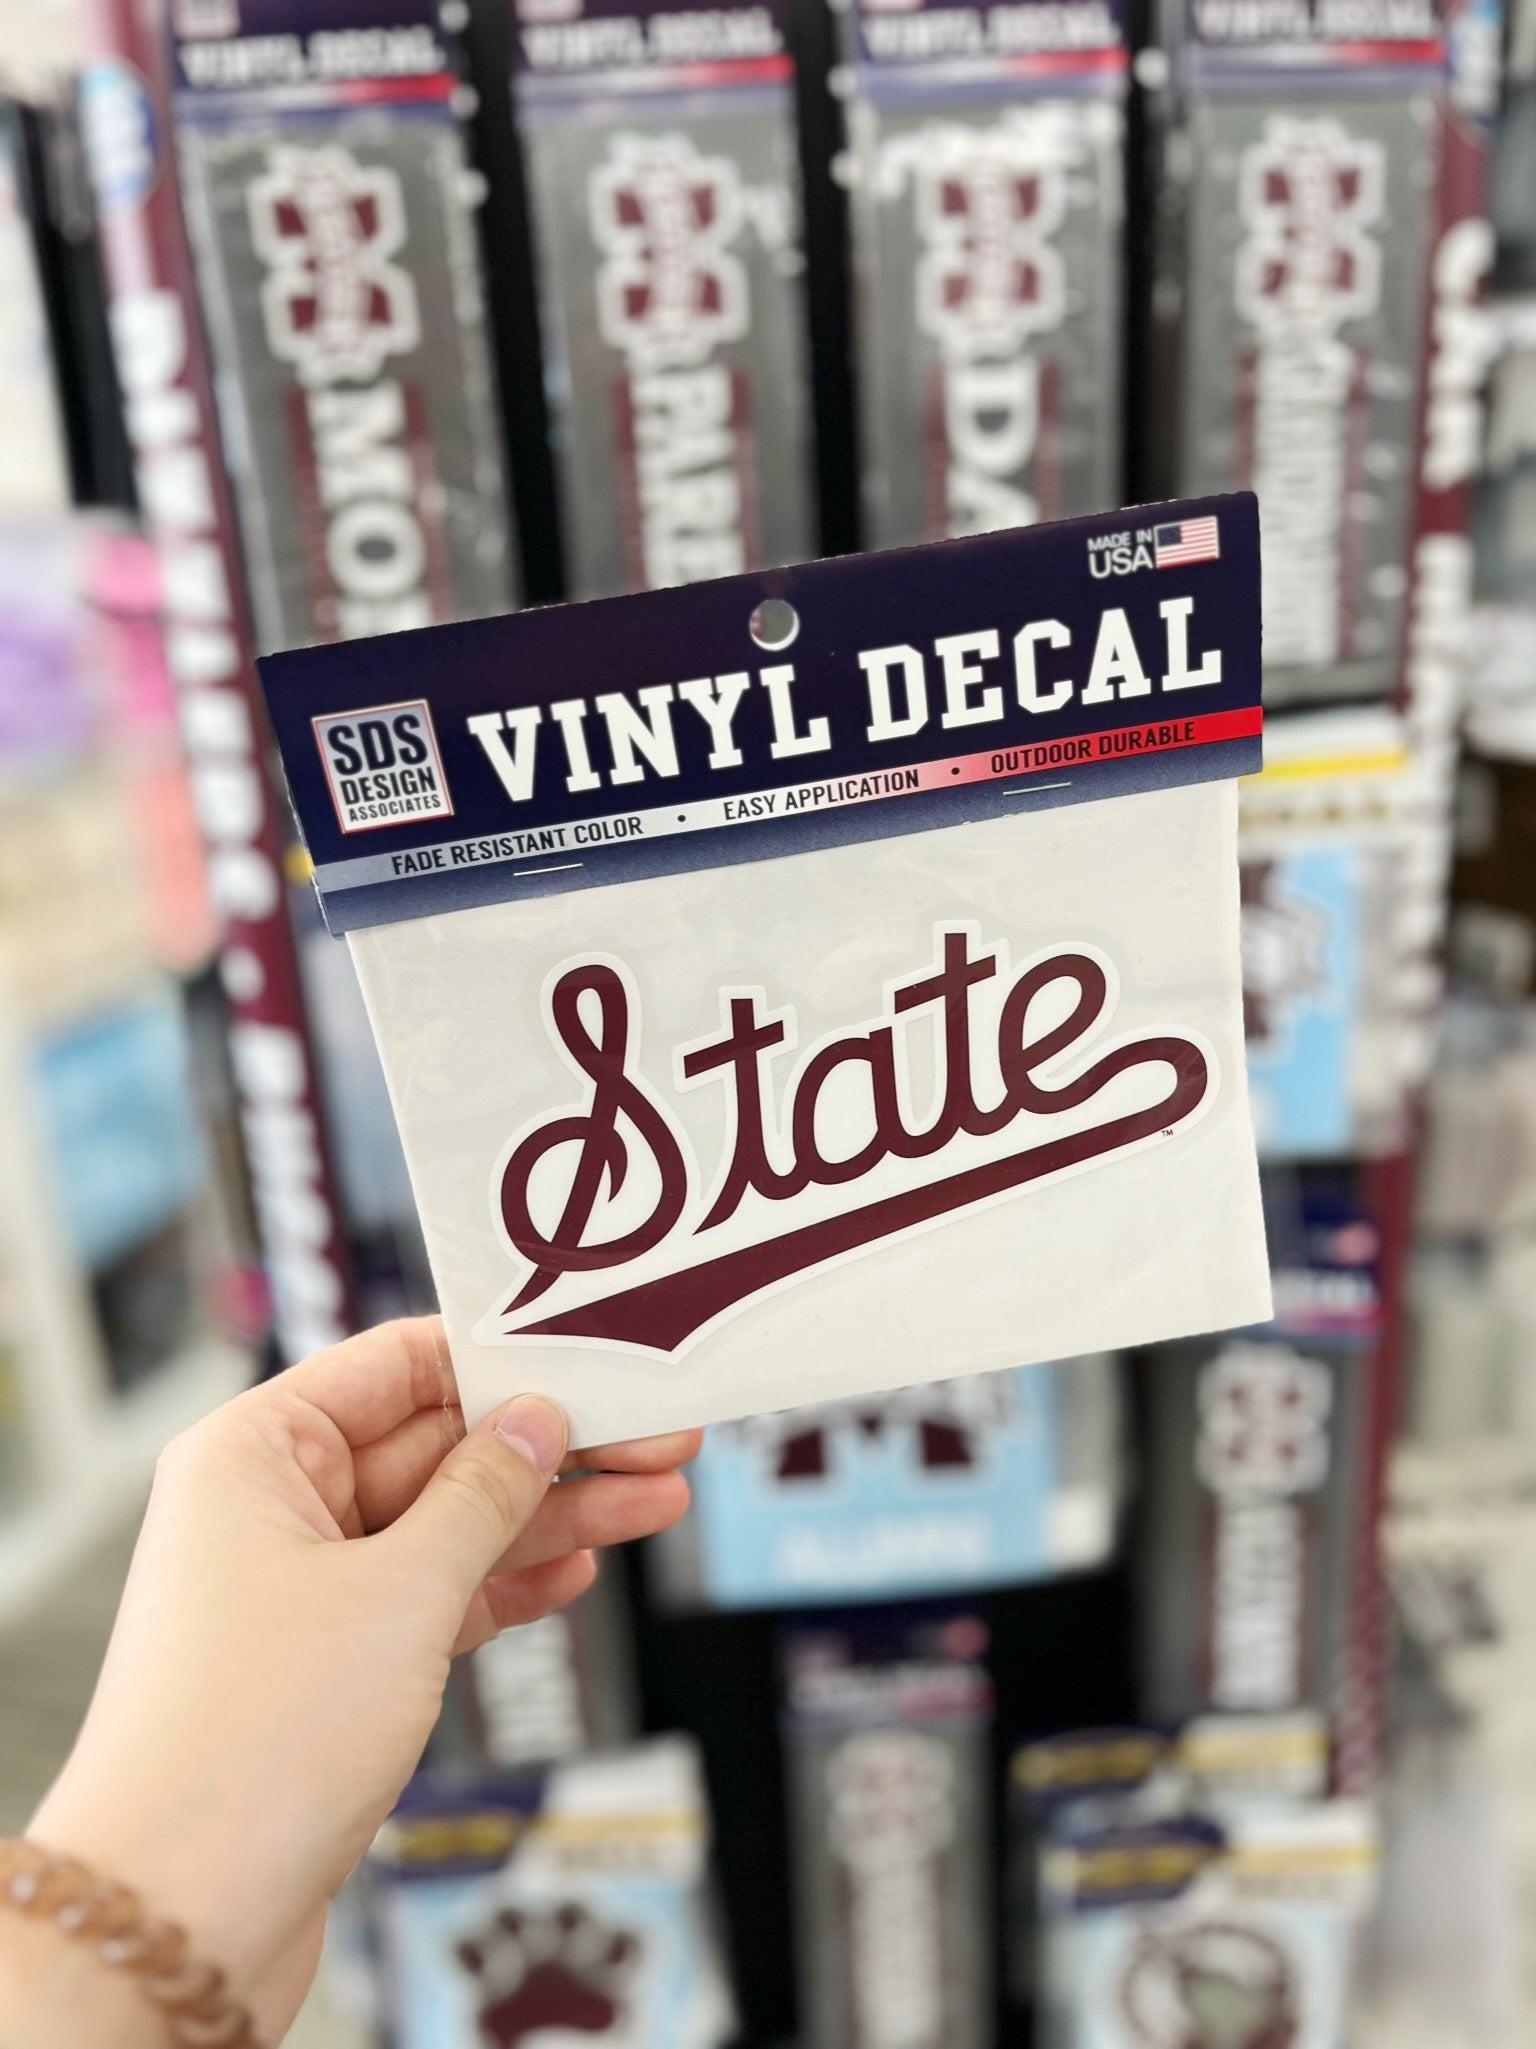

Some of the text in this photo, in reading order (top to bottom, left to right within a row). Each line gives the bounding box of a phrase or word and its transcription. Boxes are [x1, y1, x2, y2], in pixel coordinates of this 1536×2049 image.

[305, 380, 435, 639] MO
[1087, 528, 1153, 551] MADE IN
[1089, 544, 1154, 579] USA
[466, 595, 1222, 803] VINYL DECAL
[327, 713, 428, 777] SDS
[340, 766, 437, 805] DESIGN
[348, 794, 441, 822] ASSOCIATES
[391, 721, 1195, 876] FADE RESISTANT COLOR EASY APPLICATION OUTDOOR DURABLE
[500, 932, 1207, 1318] State
